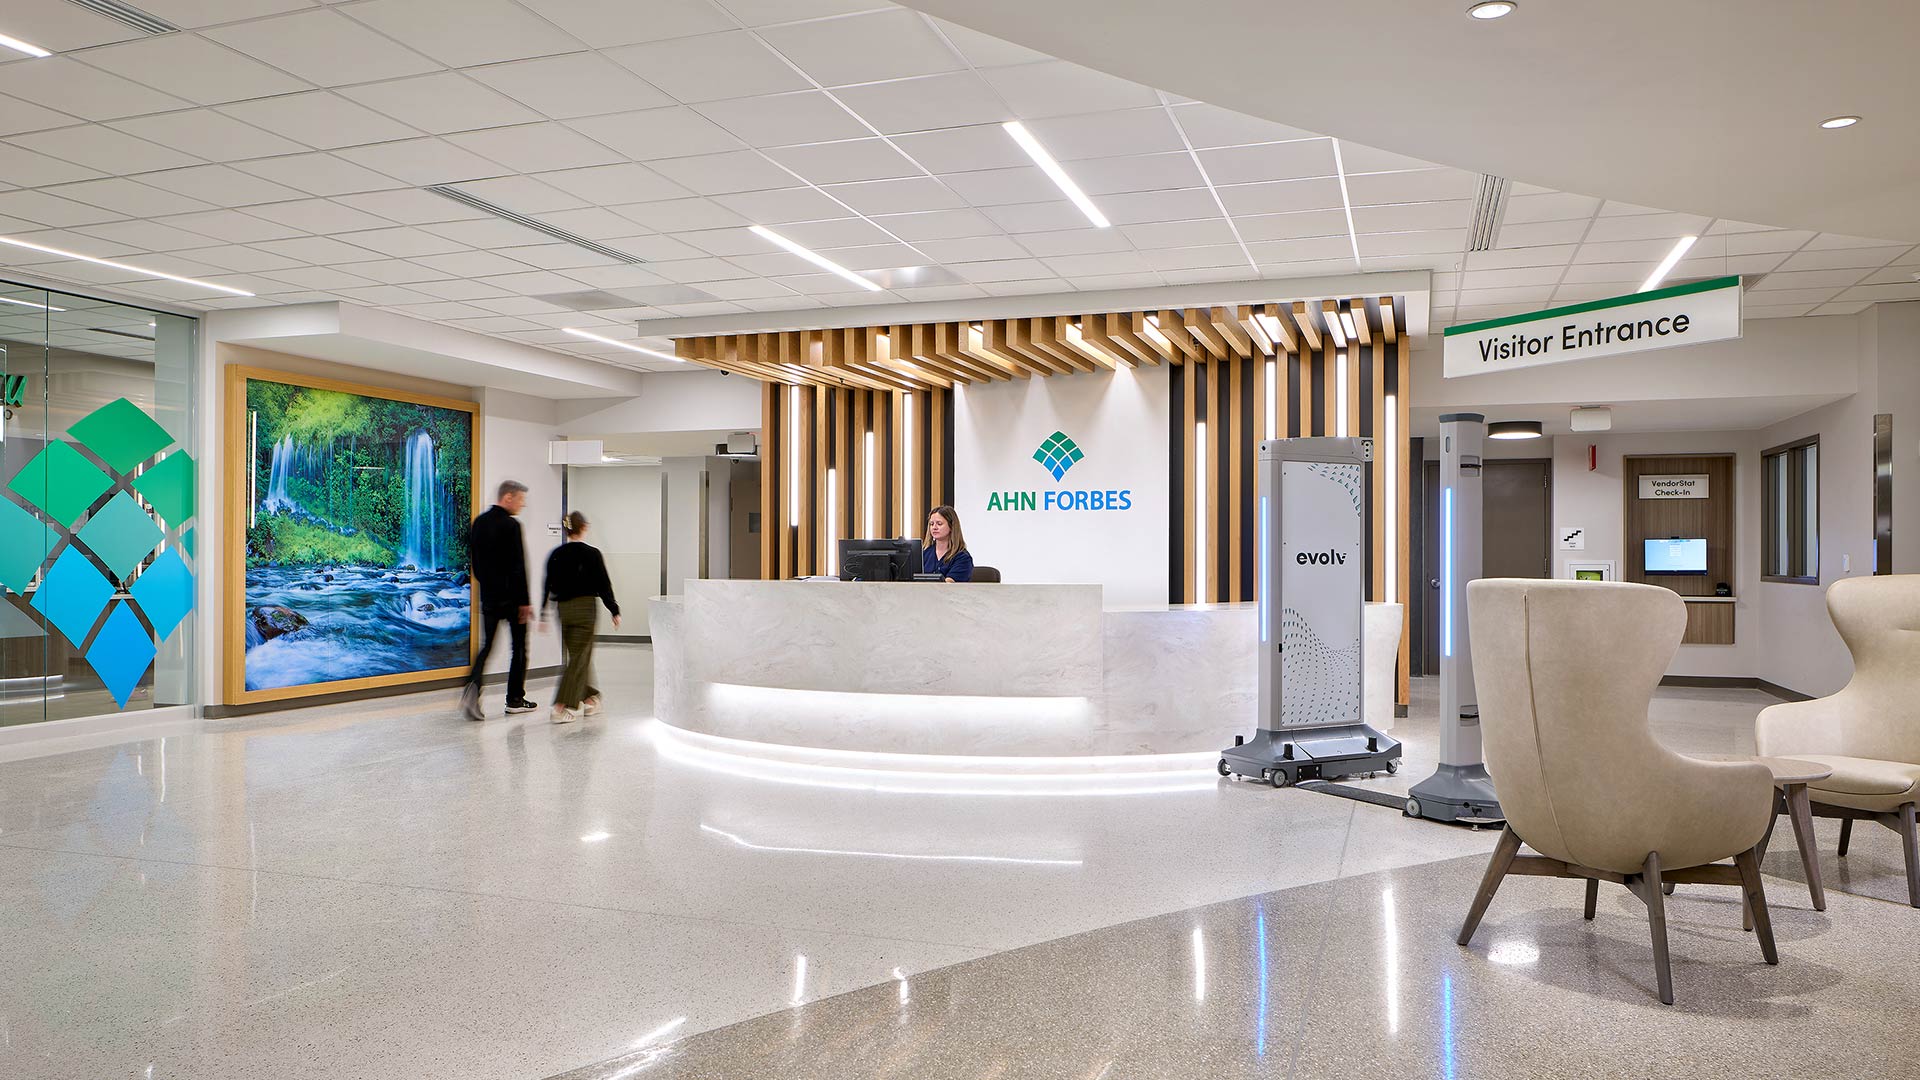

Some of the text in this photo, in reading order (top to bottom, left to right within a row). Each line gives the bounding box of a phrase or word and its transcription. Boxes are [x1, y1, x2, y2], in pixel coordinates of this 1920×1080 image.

[1479, 314, 1690, 362] Visitor Entrance
[987, 490, 1132, 511] AHN FORBES
[1296, 548, 1347, 565] evolv
